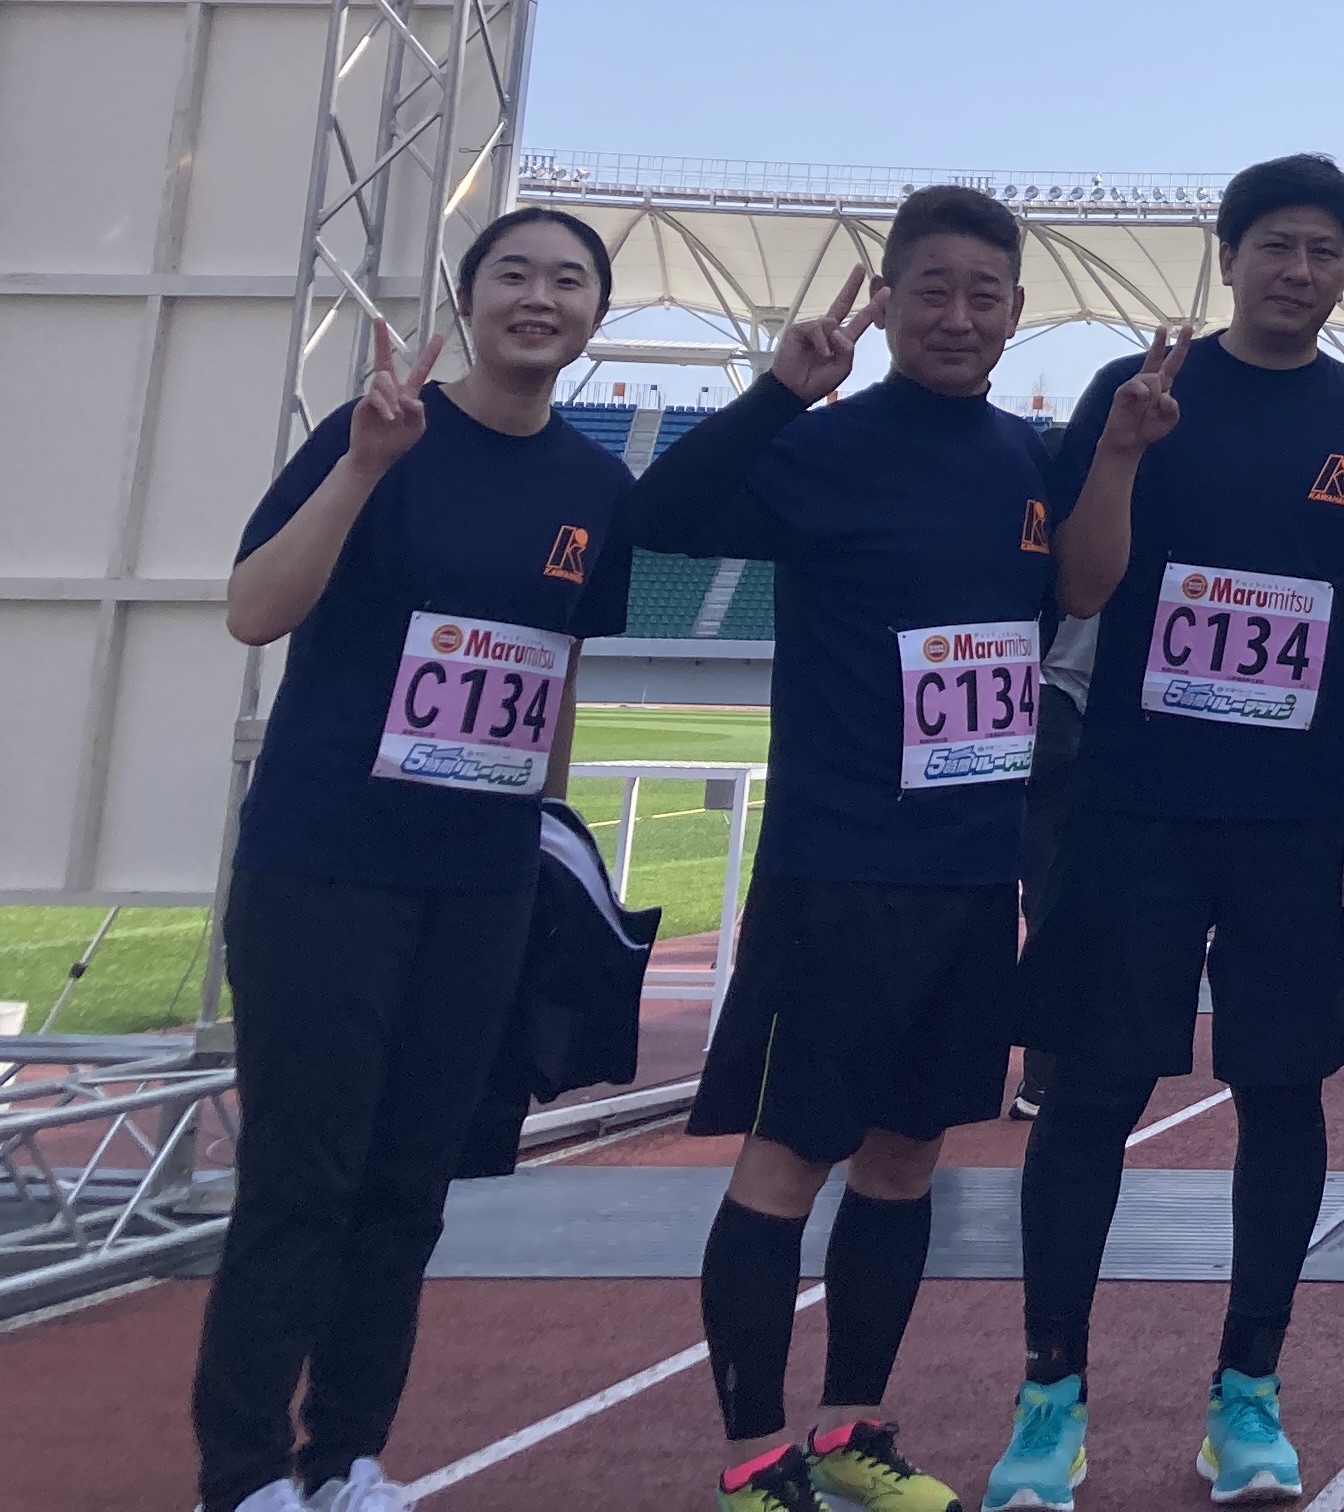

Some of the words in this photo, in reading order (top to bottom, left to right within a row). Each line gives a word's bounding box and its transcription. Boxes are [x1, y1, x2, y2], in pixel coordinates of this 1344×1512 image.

[1209, 577, 1314, 614] Marumitsu
[464, 628, 556, 669] Marumitsu
[1162, 606, 1310, 680] C134
[404, 661, 551, 743] C134
[915, 665, 1034, 737] C134
